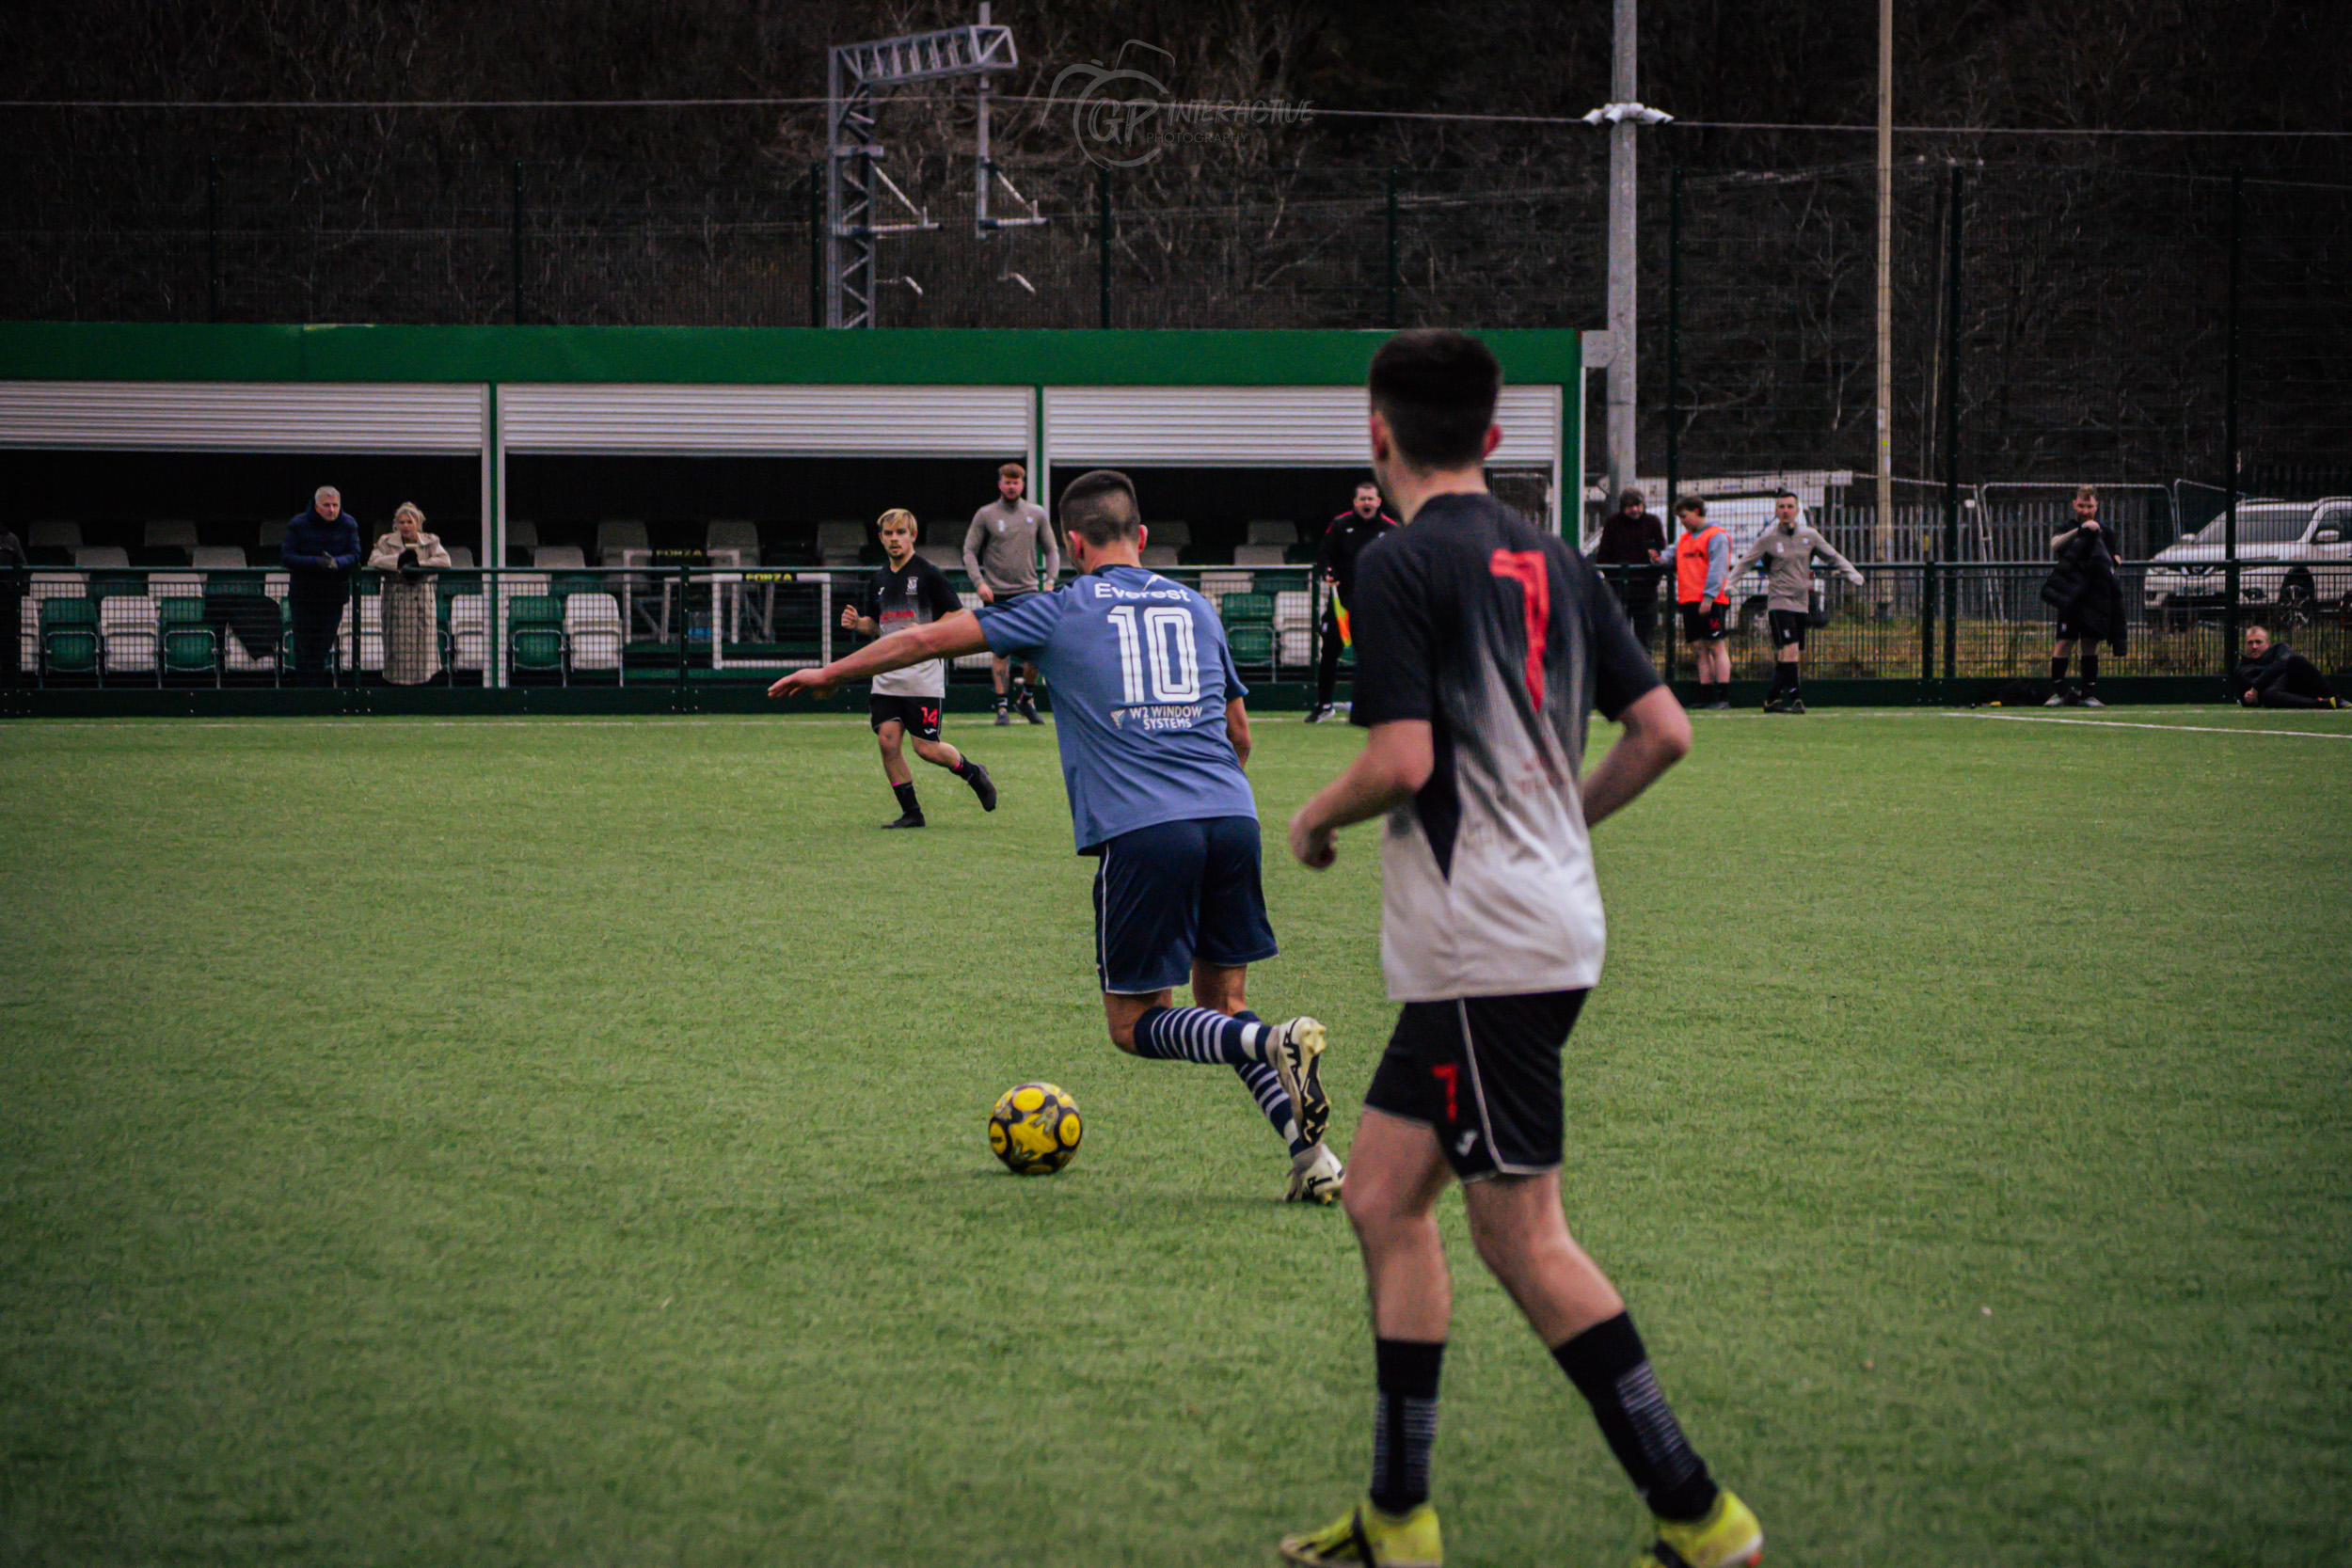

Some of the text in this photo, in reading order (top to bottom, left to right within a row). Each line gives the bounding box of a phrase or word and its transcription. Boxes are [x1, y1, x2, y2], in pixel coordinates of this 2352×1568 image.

[1094, 582, 1191, 602] Everest
[1489, 548, 1549, 713] 7
[1106, 605, 1200, 704] 10
[920, 706, 939, 727] 14
[1130, 705, 1203, 719] W2 WINDOW
[1143, 718, 1193, 730] SYSTEMS
[1431, 1063, 1458, 1121] 7
